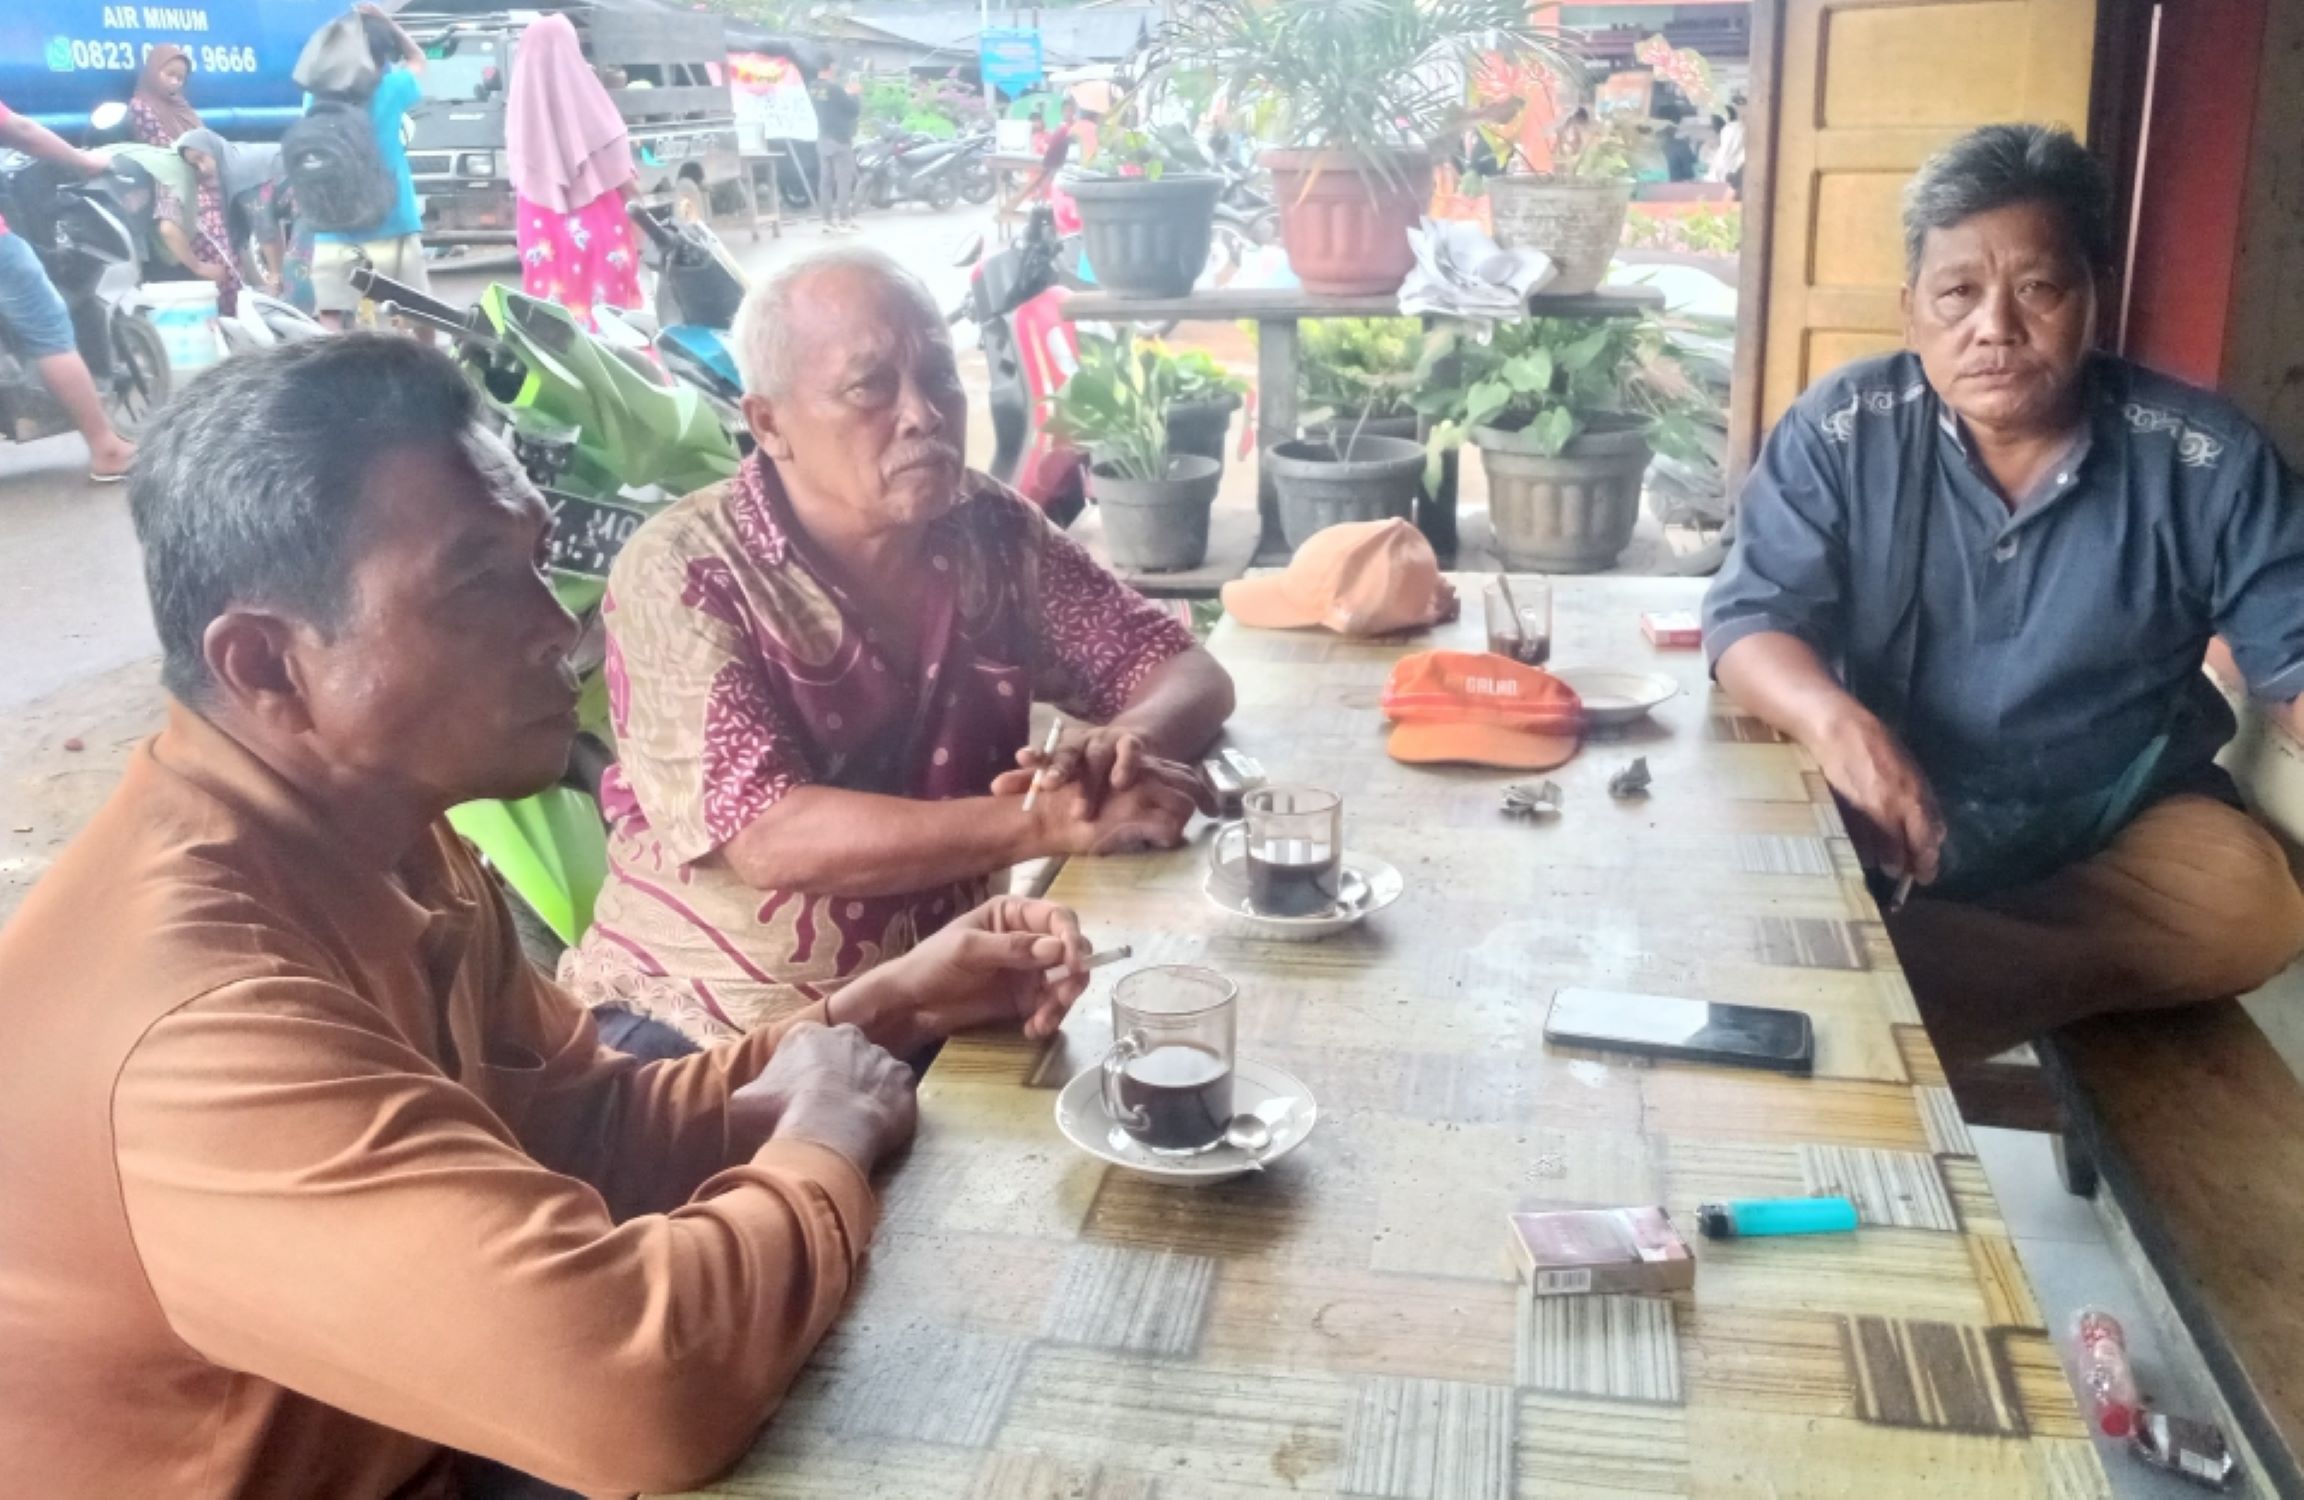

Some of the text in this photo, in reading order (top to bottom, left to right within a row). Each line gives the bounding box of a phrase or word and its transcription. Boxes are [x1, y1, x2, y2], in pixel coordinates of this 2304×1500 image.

[104, 6, 209, 31] AIR MINUM
[71, 40, 135, 70] 0823
[202, 45, 257, 73] 9666
